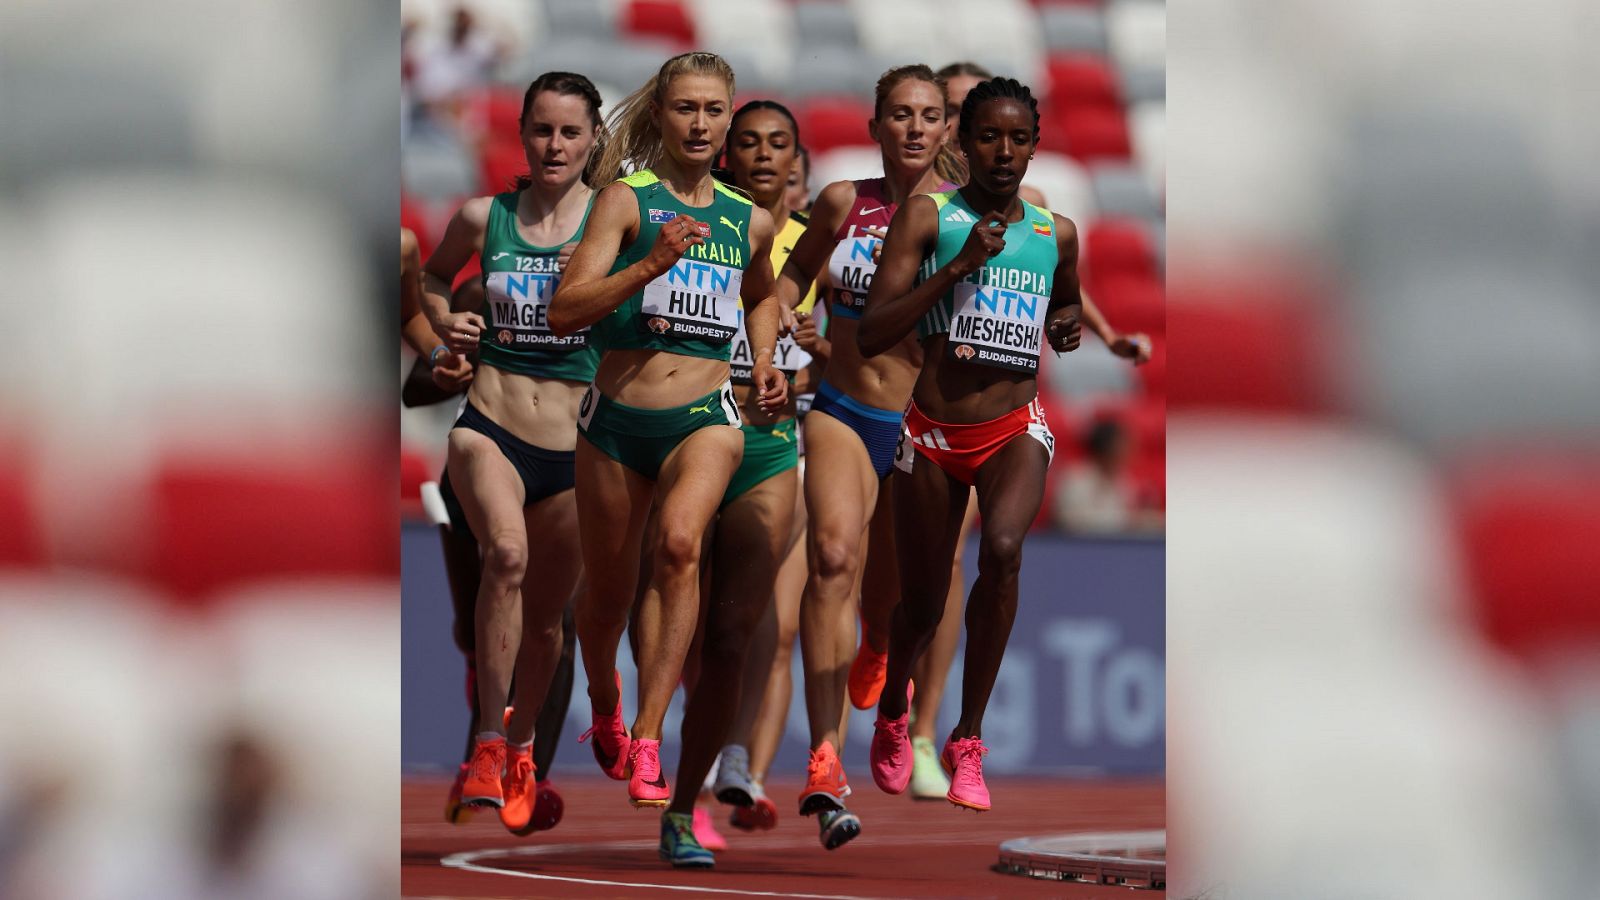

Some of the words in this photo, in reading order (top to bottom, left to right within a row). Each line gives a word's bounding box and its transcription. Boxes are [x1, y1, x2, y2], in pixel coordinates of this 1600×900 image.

[684, 239, 742, 267] TRALIA
[667, 262, 732, 294] NTN
[495, 302, 547, 327] MAGE
[668, 290, 721, 321] HULL
[974, 287, 1037, 321] NTN
[516, 334, 573, 345] BUDAPEST
[573, 335, 585, 344] 23
[674, 323, 726, 338] BUDAPEST
[955, 315, 1040, 351] MESHESHA
[979, 350, 1029, 367] BUDAPEST
[1028, 359, 1037, 368] 23
